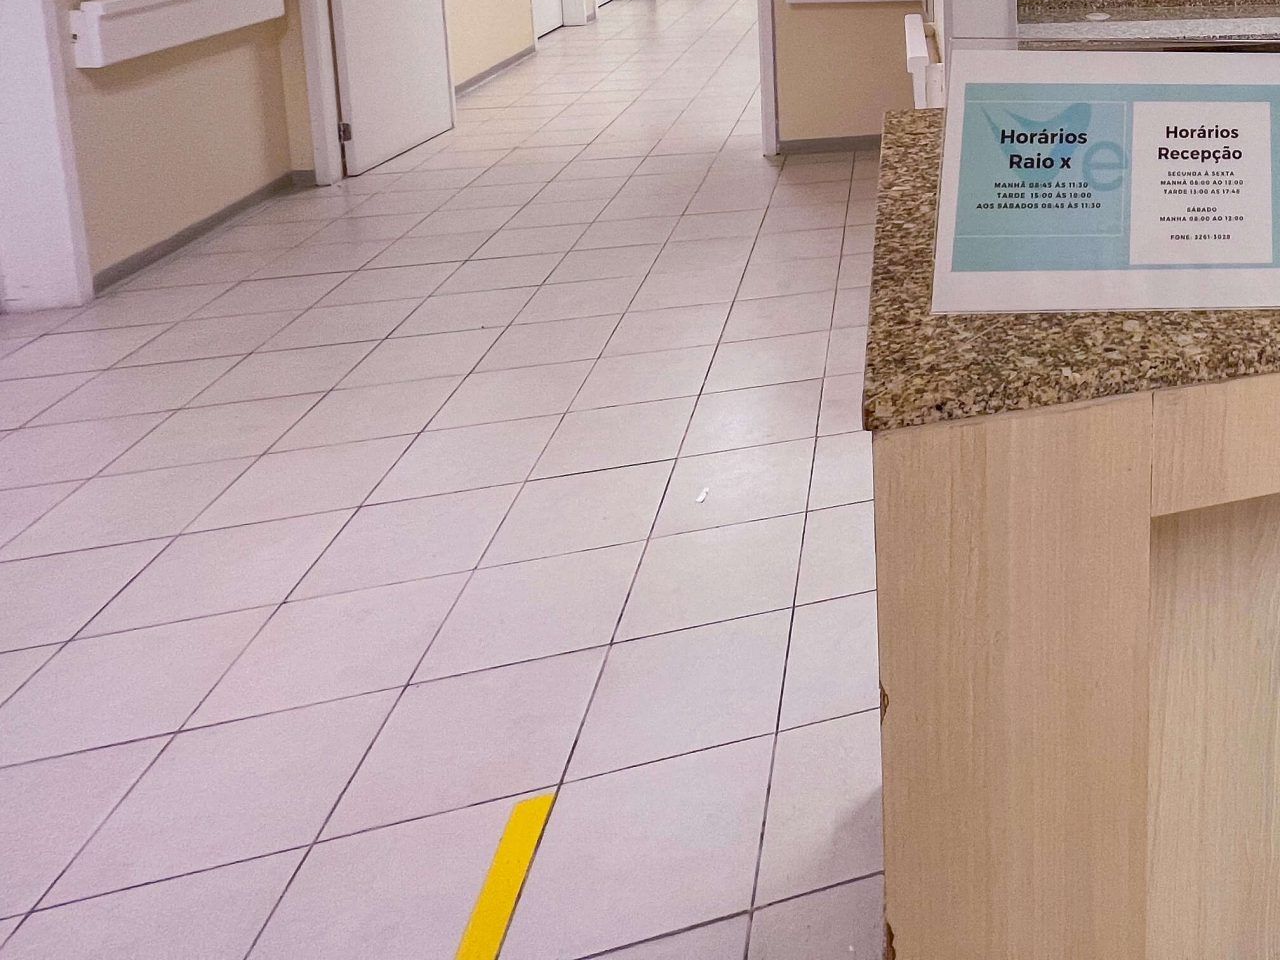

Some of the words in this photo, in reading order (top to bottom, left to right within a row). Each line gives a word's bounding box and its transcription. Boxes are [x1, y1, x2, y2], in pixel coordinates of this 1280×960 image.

[1000, 128, 1088, 144] Horários
[1166, 125, 1239, 139] Horários
[1009, 152, 1054, 169] Raio
[1158, 146, 1243, 164] Recepção
